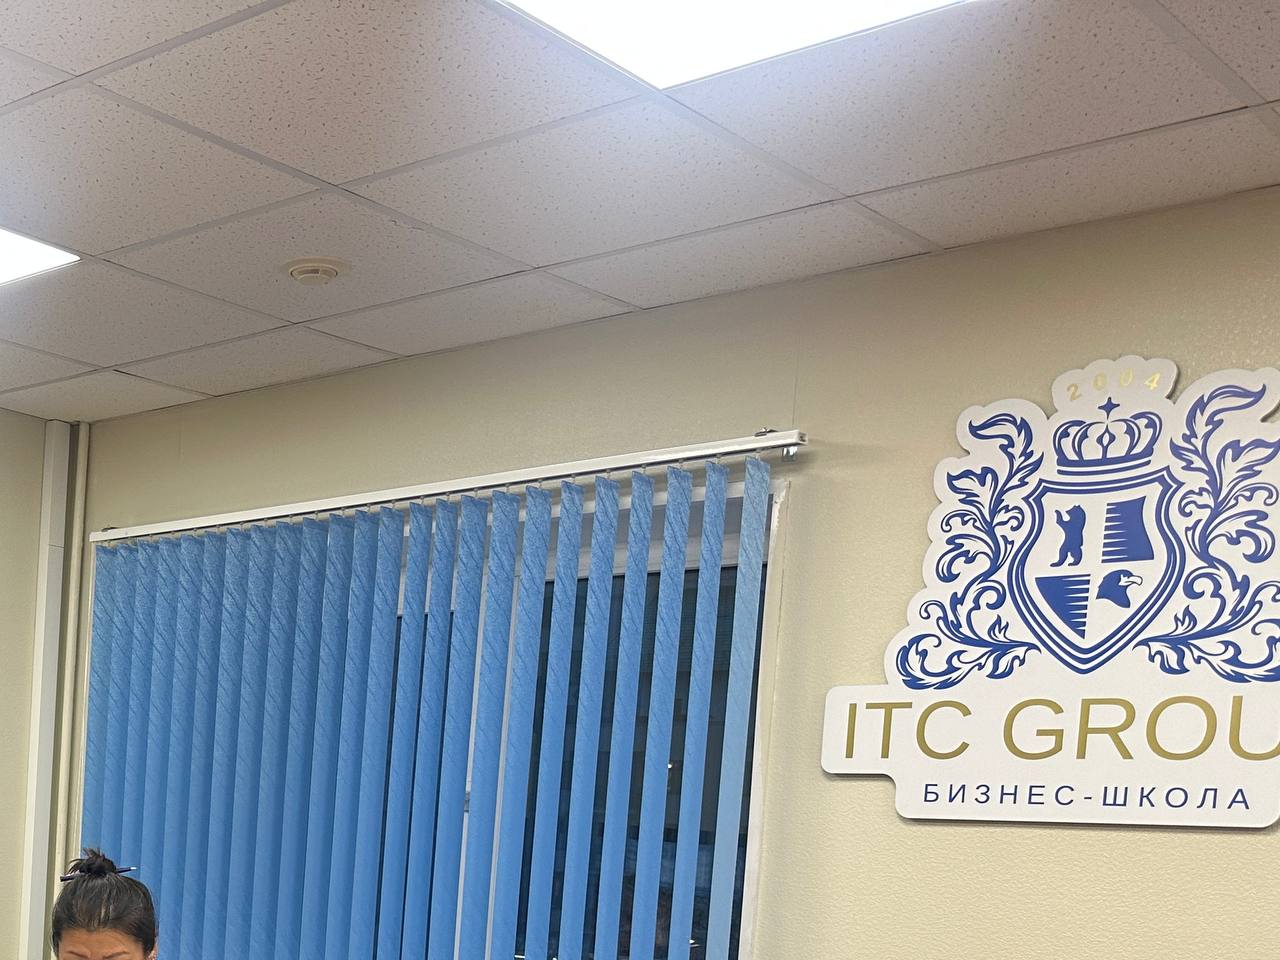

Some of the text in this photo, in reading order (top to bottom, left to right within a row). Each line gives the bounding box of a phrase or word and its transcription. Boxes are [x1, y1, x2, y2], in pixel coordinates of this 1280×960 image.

[1066, 367, 1161, 402] 2004
[844, 700, 972, 760] ITC
[923, 782, 1251, 810] БИЗНЕС-ШКОЛА
